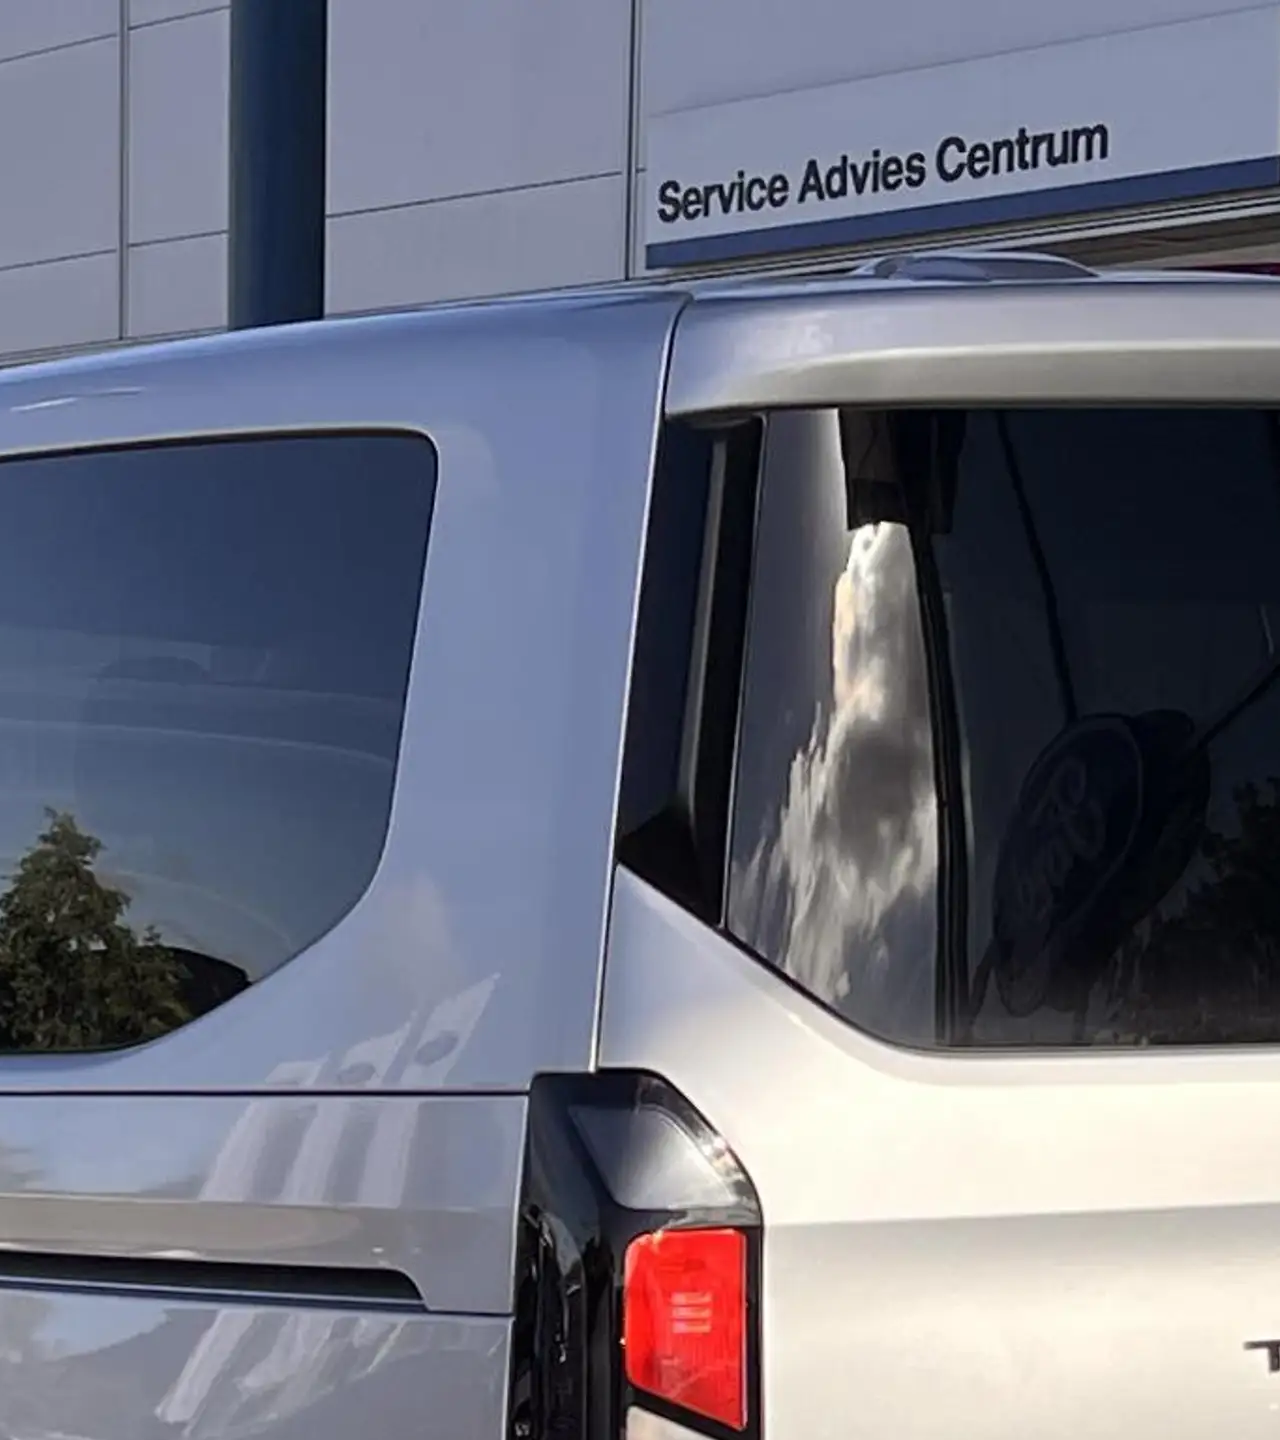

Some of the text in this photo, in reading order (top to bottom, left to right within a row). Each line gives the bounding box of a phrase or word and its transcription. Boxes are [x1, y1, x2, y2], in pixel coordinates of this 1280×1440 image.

[657, 122, 1108, 223] Service Advies Centrum
